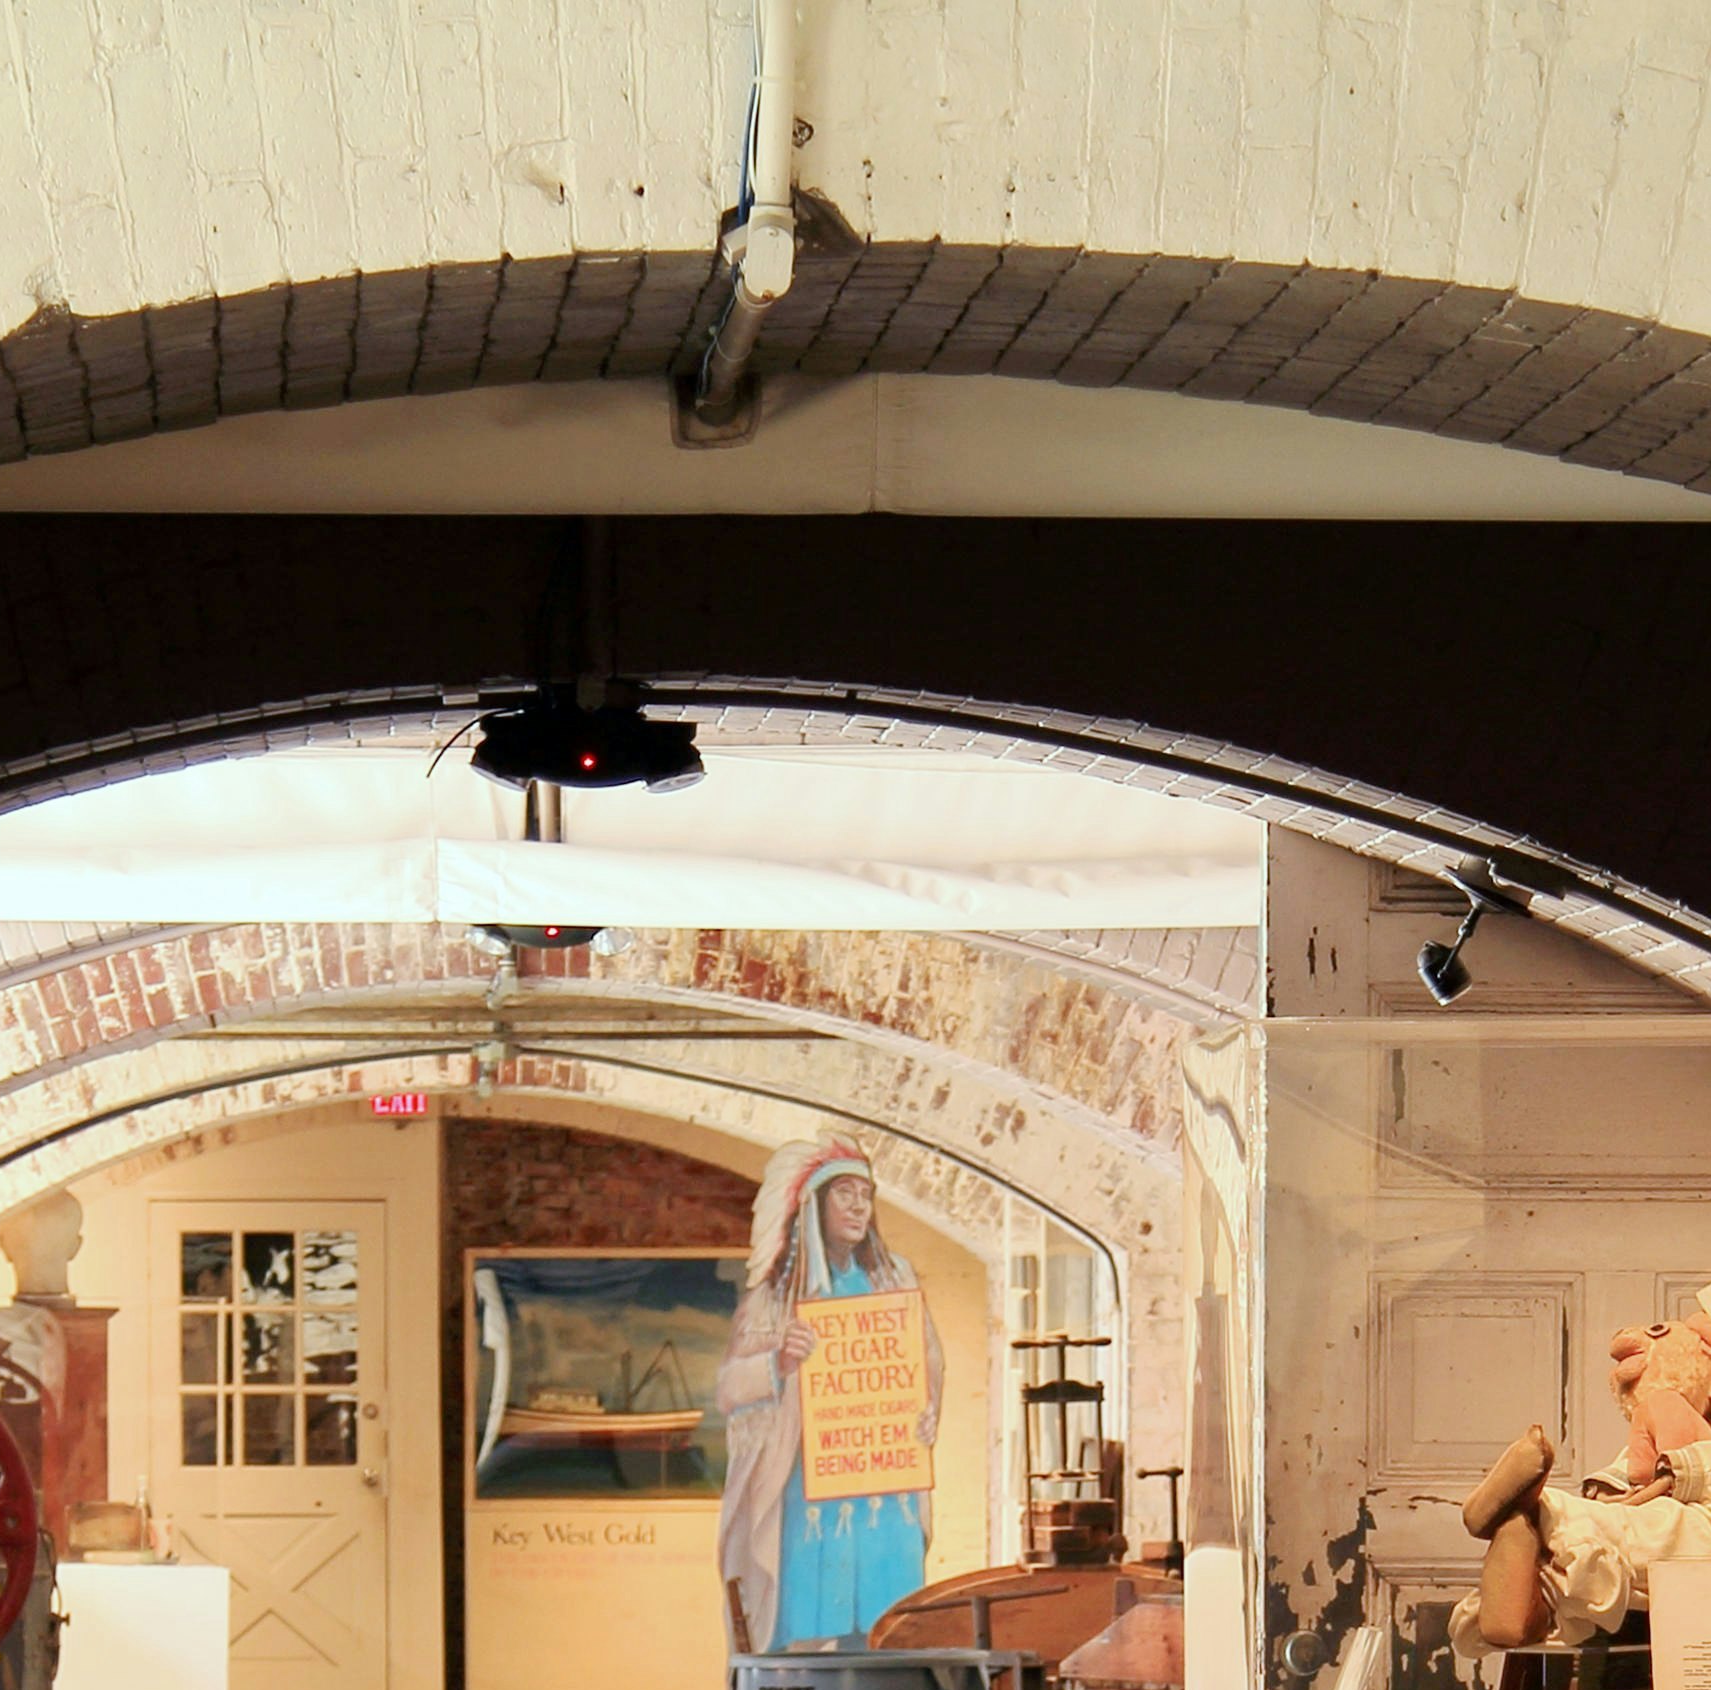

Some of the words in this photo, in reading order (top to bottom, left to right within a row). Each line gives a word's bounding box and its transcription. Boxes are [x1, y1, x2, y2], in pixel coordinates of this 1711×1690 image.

[810, 1312, 848, 1338] KEY
[854, 1307, 908, 1335] WEST
[825, 1336, 905, 1366] CIGAR
[810, 1362, 919, 1397] FACTORY
[818, 1426, 874, 1450] WATCH
[815, 1451, 866, 1477] BEING
[870, 1447, 918, 1473] MADE
[492, 1521, 532, 1550] Key
[543, 1522, 595, 1546] West
[603, 1522, 656, 1546] Gold
